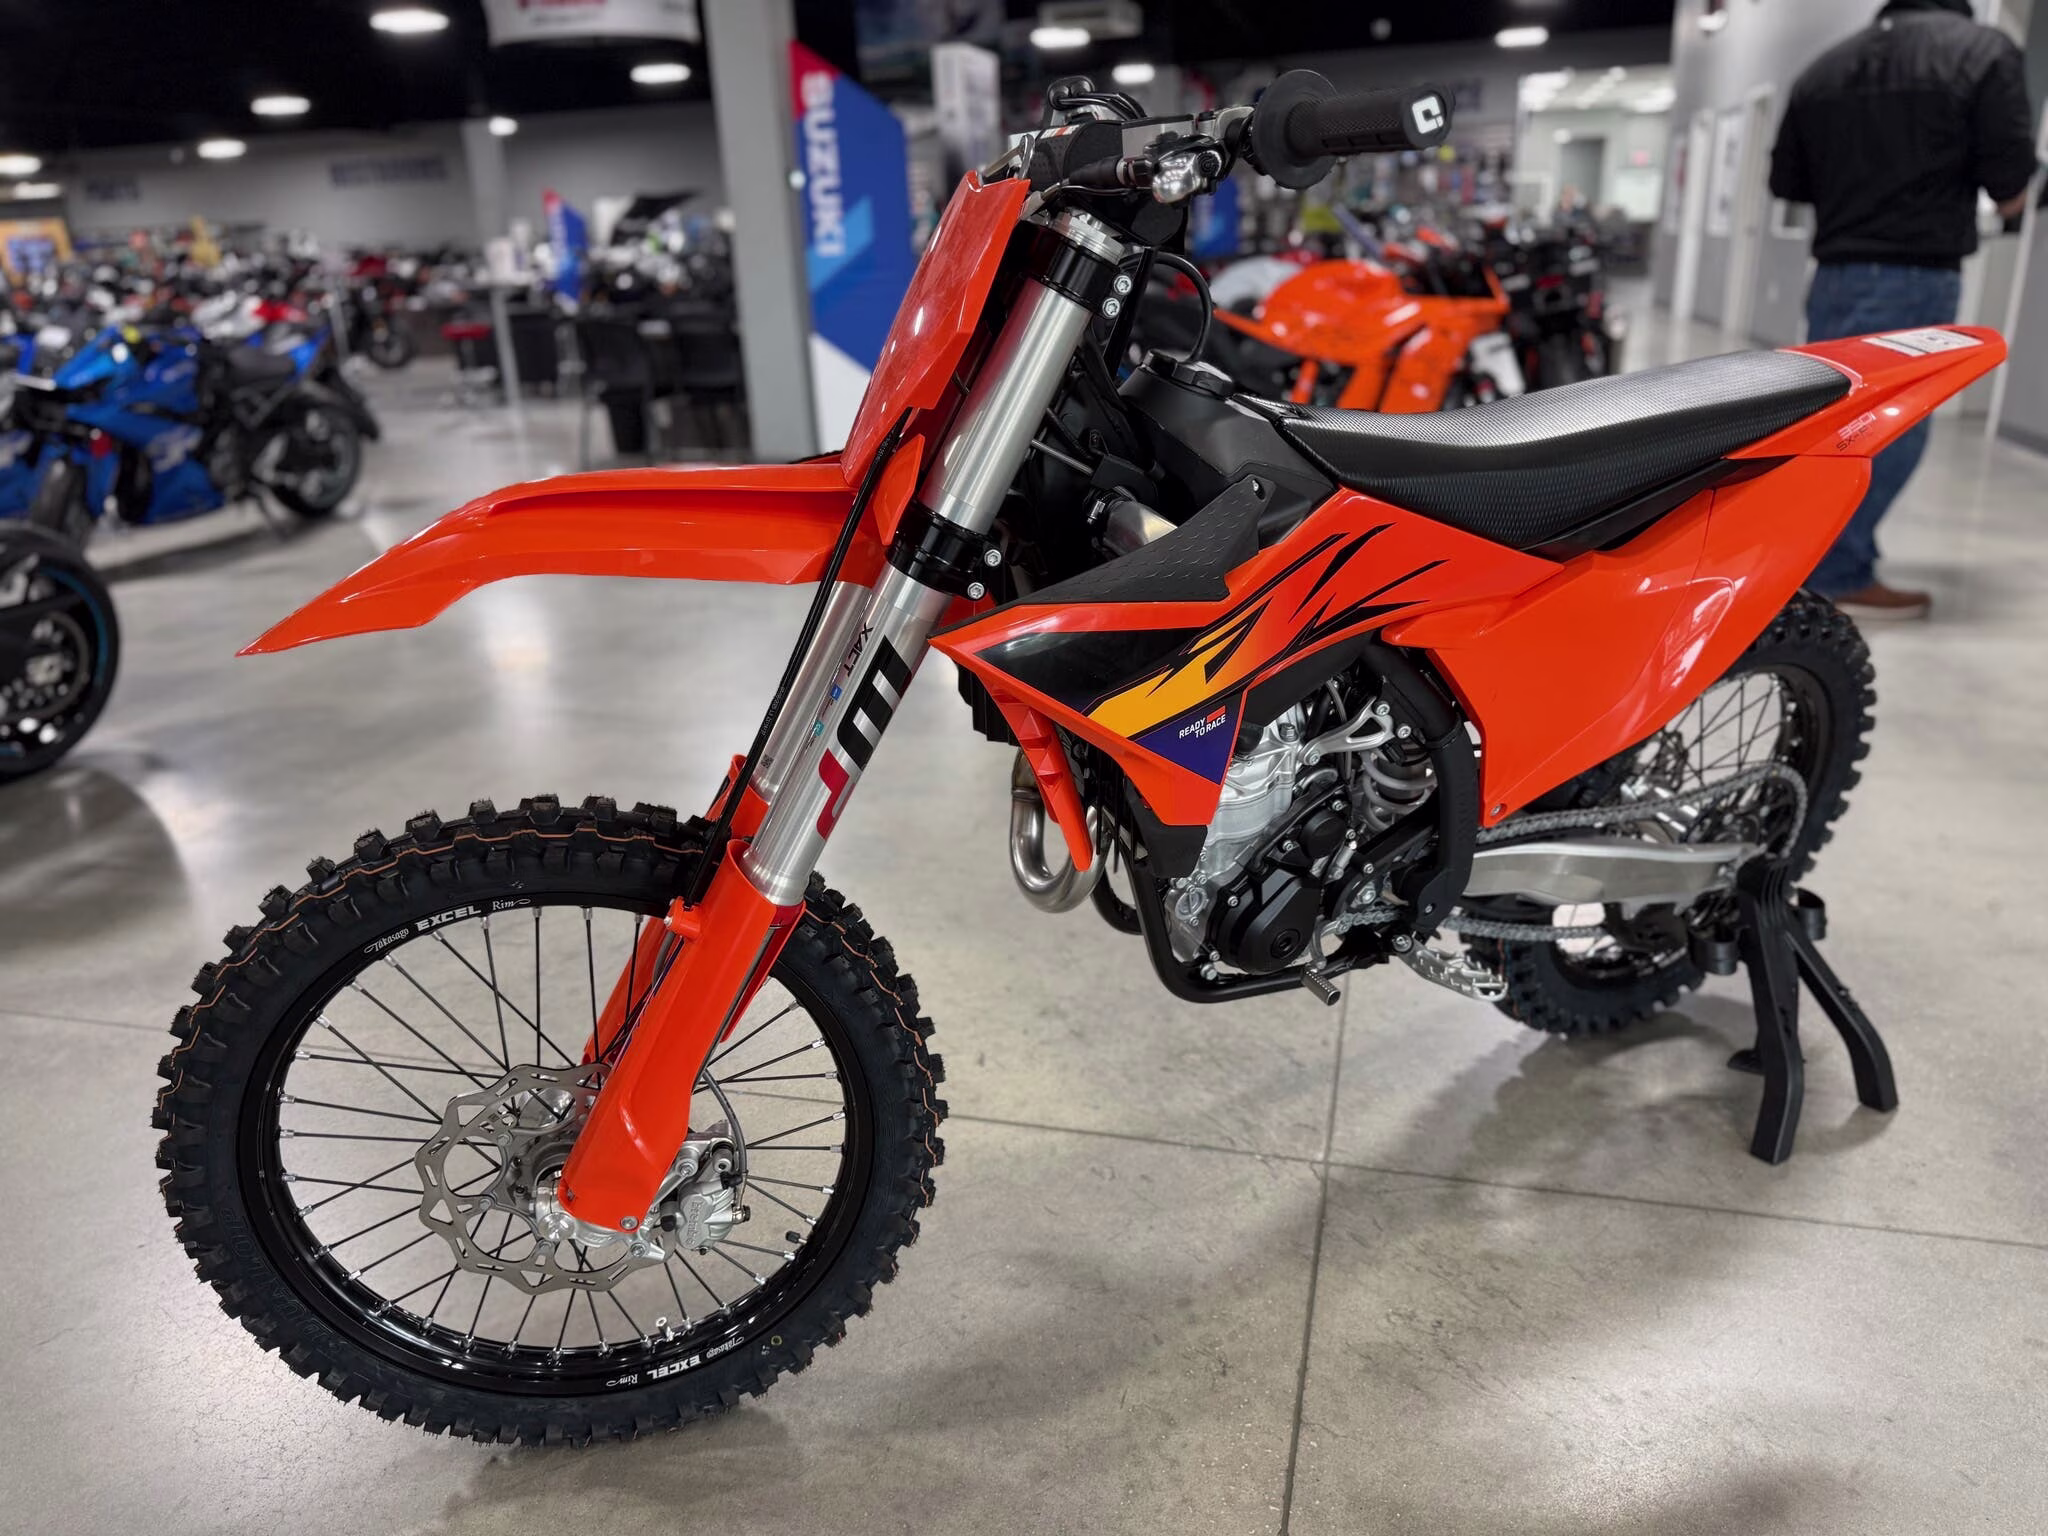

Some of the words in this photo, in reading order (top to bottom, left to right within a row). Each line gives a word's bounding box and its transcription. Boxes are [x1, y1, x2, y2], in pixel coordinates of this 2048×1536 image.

[801, 70, 846, 257] SUZUKI
[843, 622, 874, 677] XACT
[1179, 717, 1206, 739] READY
[1195, 728, 1206, 738] TO
[1206, 714, 1226, 733] RACE
[364, 927, 409, 953] Takasago
[415, 905, 482, 932] EXCEL
[647, 1355, 702, 1380] EXCEL
